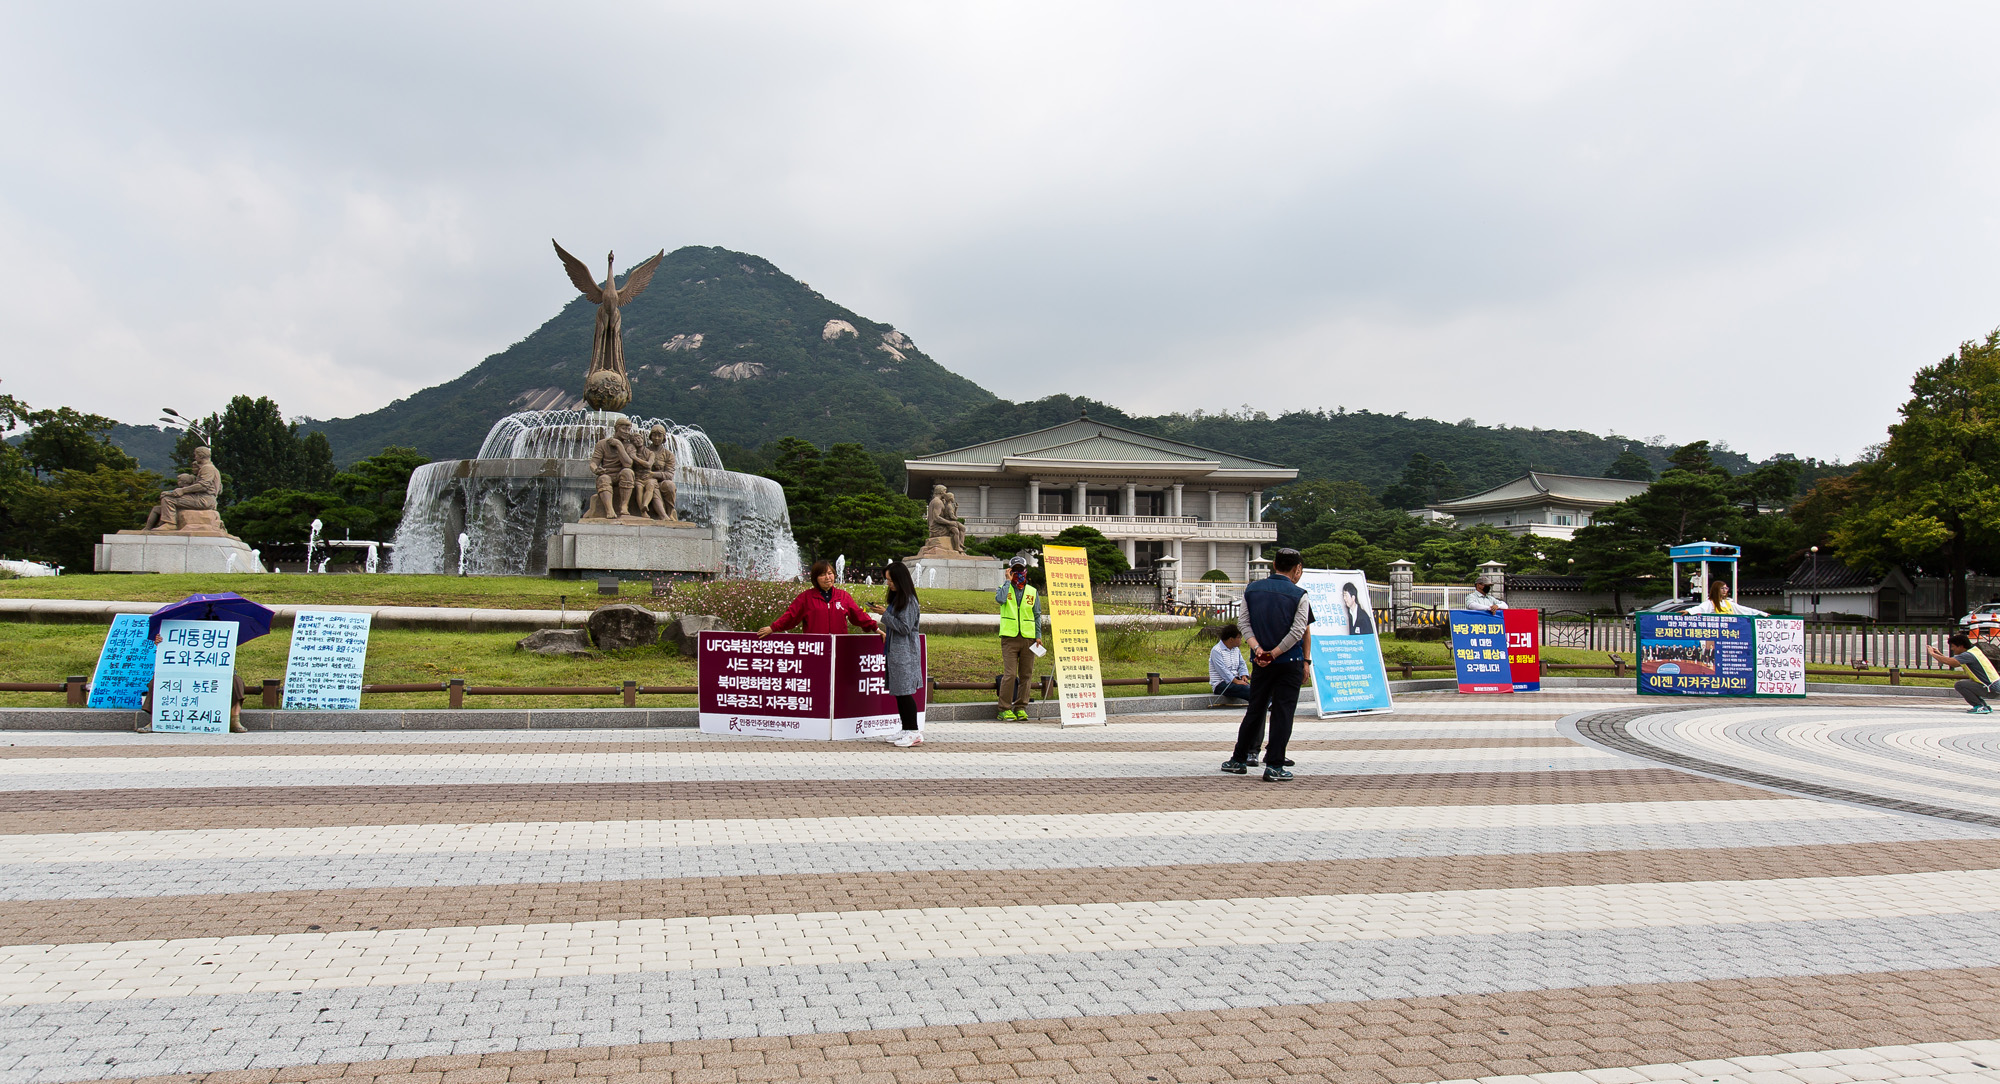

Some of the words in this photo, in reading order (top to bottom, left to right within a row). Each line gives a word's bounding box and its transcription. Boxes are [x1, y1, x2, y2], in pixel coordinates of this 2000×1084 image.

[1312, 604, 1344, 616] 석기의원을
[1452, 624, 1469, 634] 부당
[1470, 624, 1486, 634] 계약
[1488, 624, 1504, 634] 파기
[1776, 620, 1788, 630] 하는
[168, 628, 230, 648] 대통령님
[1655, 628, 1682, 638] 문재인
[1685, 628, 1720, 639] 대통령의
[1721, 629, 1740, 639] 약속!
[110, 638, 135, 647] 미래의
[706, 638, 796, 655] UFG북침전쟁연습
[798, 641, 824, 656] 반대!
[1478, 638, 1492, 646] 대한
[1456, 649, 1480, 660] 책임과
[1482, 649, 1506, 660] 배상을
[1508, 655, 1514, 664] 연
[1516, 655, 1536, 664] 회장님!
[726, 658, 748, 672] 사드
[752, 658, 774, 672] 즉각
[776, 659, 802, 674] 철거!
[1466, 664, 1500, 672] 요구합니다!
[1756, 656, 1789, 668] 대통령님의
[160, 679, 182, 693] 저의
[192, 680, 219, 694] 농토를
[718, 676, 782, 692] 북미평화협정
[785, 677, 810, 692] 체결!
[1650, 676, 1673, 688] 이젠
[1677, 676, 1747, 689] 지켜주십시오!!
[716, 694, 763, 709] 민족공조!
[766, 694, 812, 711] 자주통일!
[740, 718, 800, 730] 민중민주당(환수복지당)
